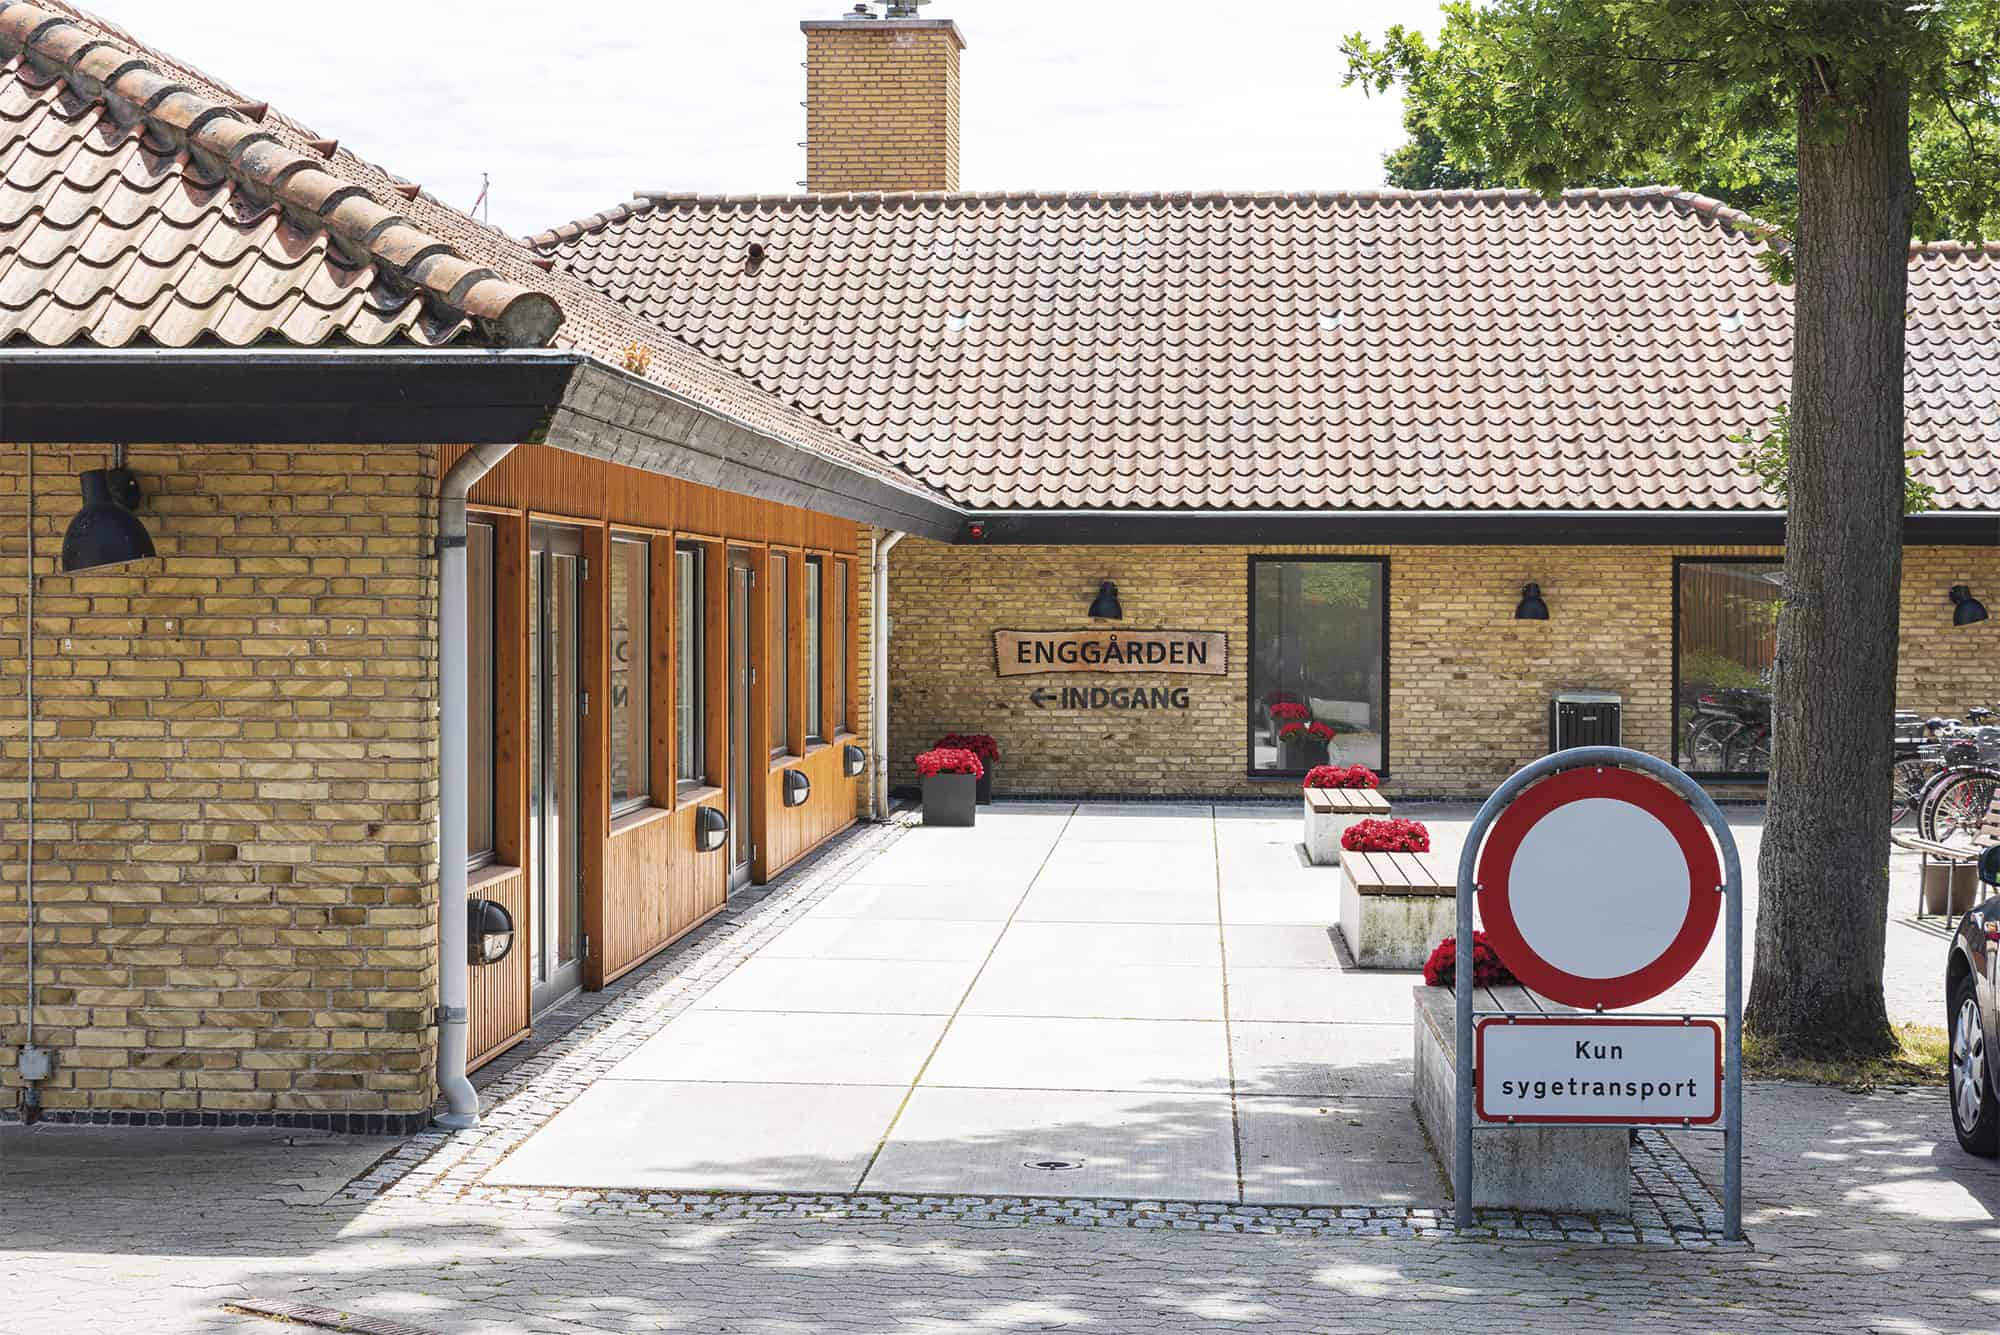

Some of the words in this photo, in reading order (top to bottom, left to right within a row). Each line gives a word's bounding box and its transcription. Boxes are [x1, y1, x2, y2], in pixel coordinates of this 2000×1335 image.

[1017, 634, 1207, 664] ENGGÅRDEN
[1062, 687, 1189, 709] INDGANG
[1576, 1041, 1623, 1059] Kun
[1502, 1078, 1697, 1100] sygetransport
